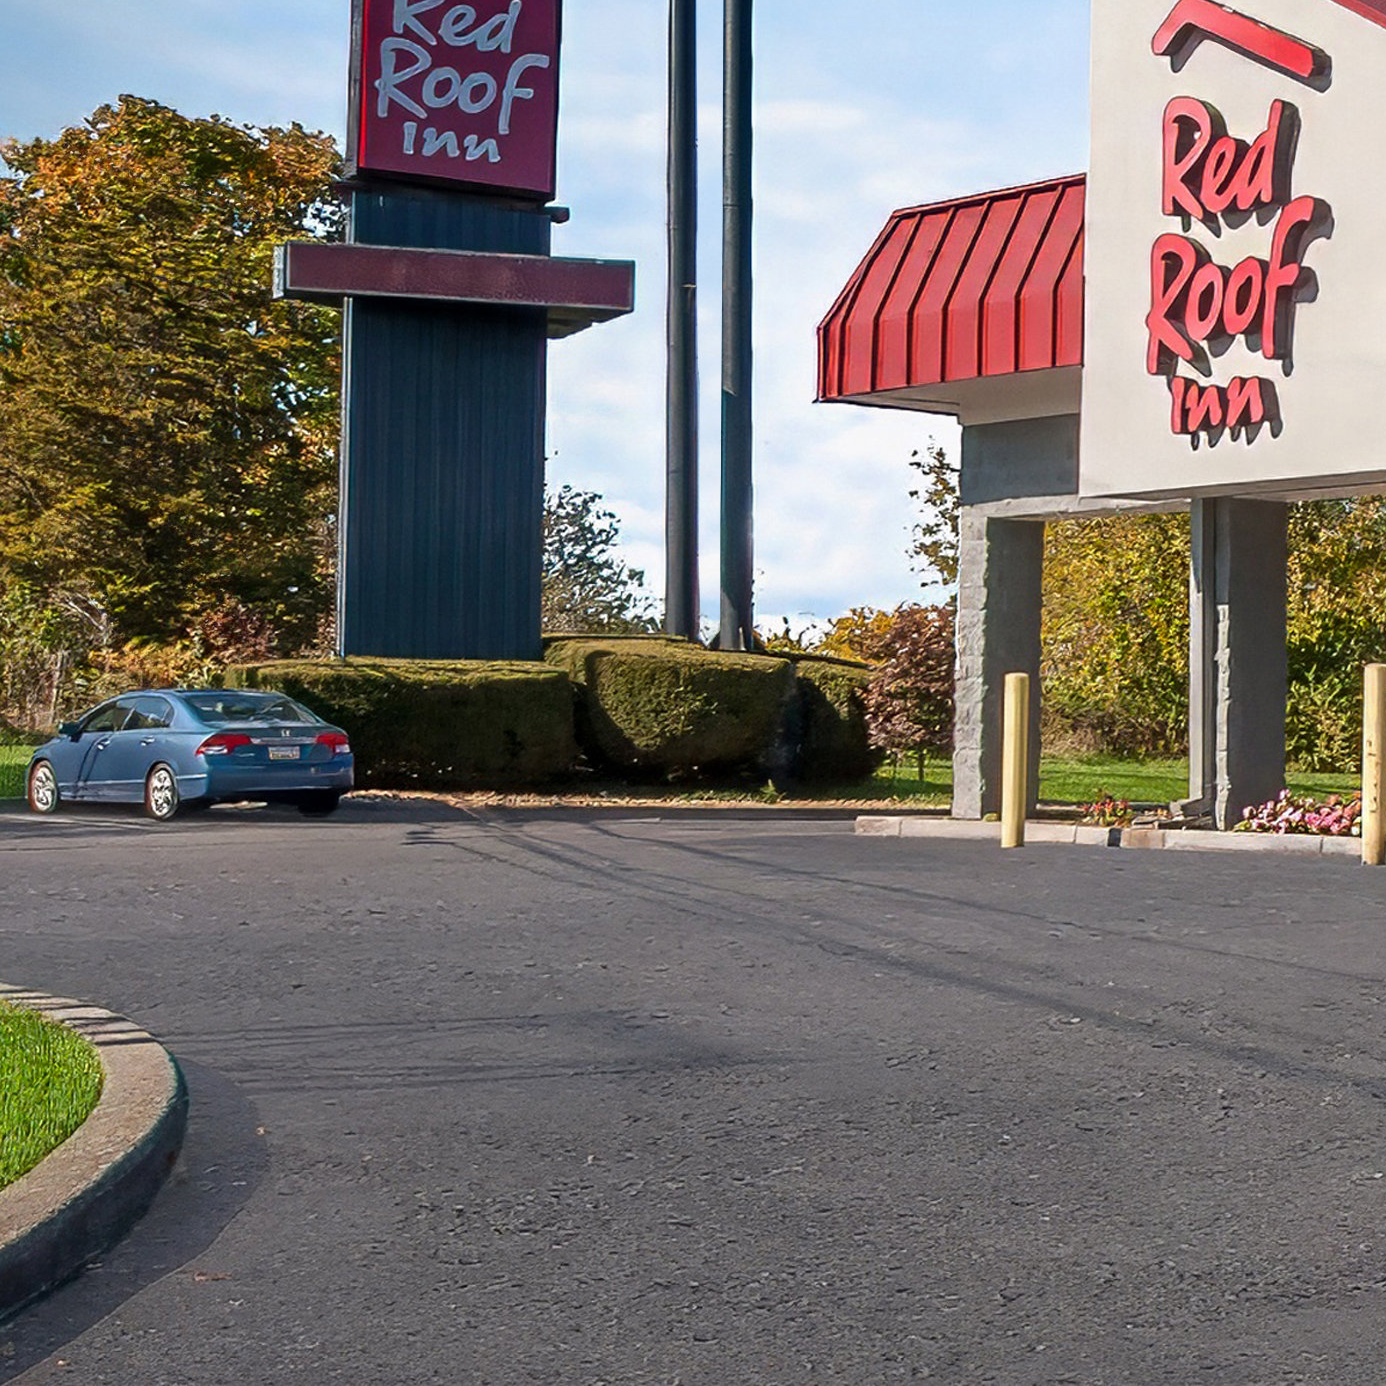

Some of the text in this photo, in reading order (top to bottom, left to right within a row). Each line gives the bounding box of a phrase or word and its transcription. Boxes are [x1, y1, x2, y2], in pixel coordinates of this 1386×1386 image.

[375, 37, 550, 134] Roof
[1162, 96, 1285, 222] Red
[1146, 196, 1313, 375] Roof
